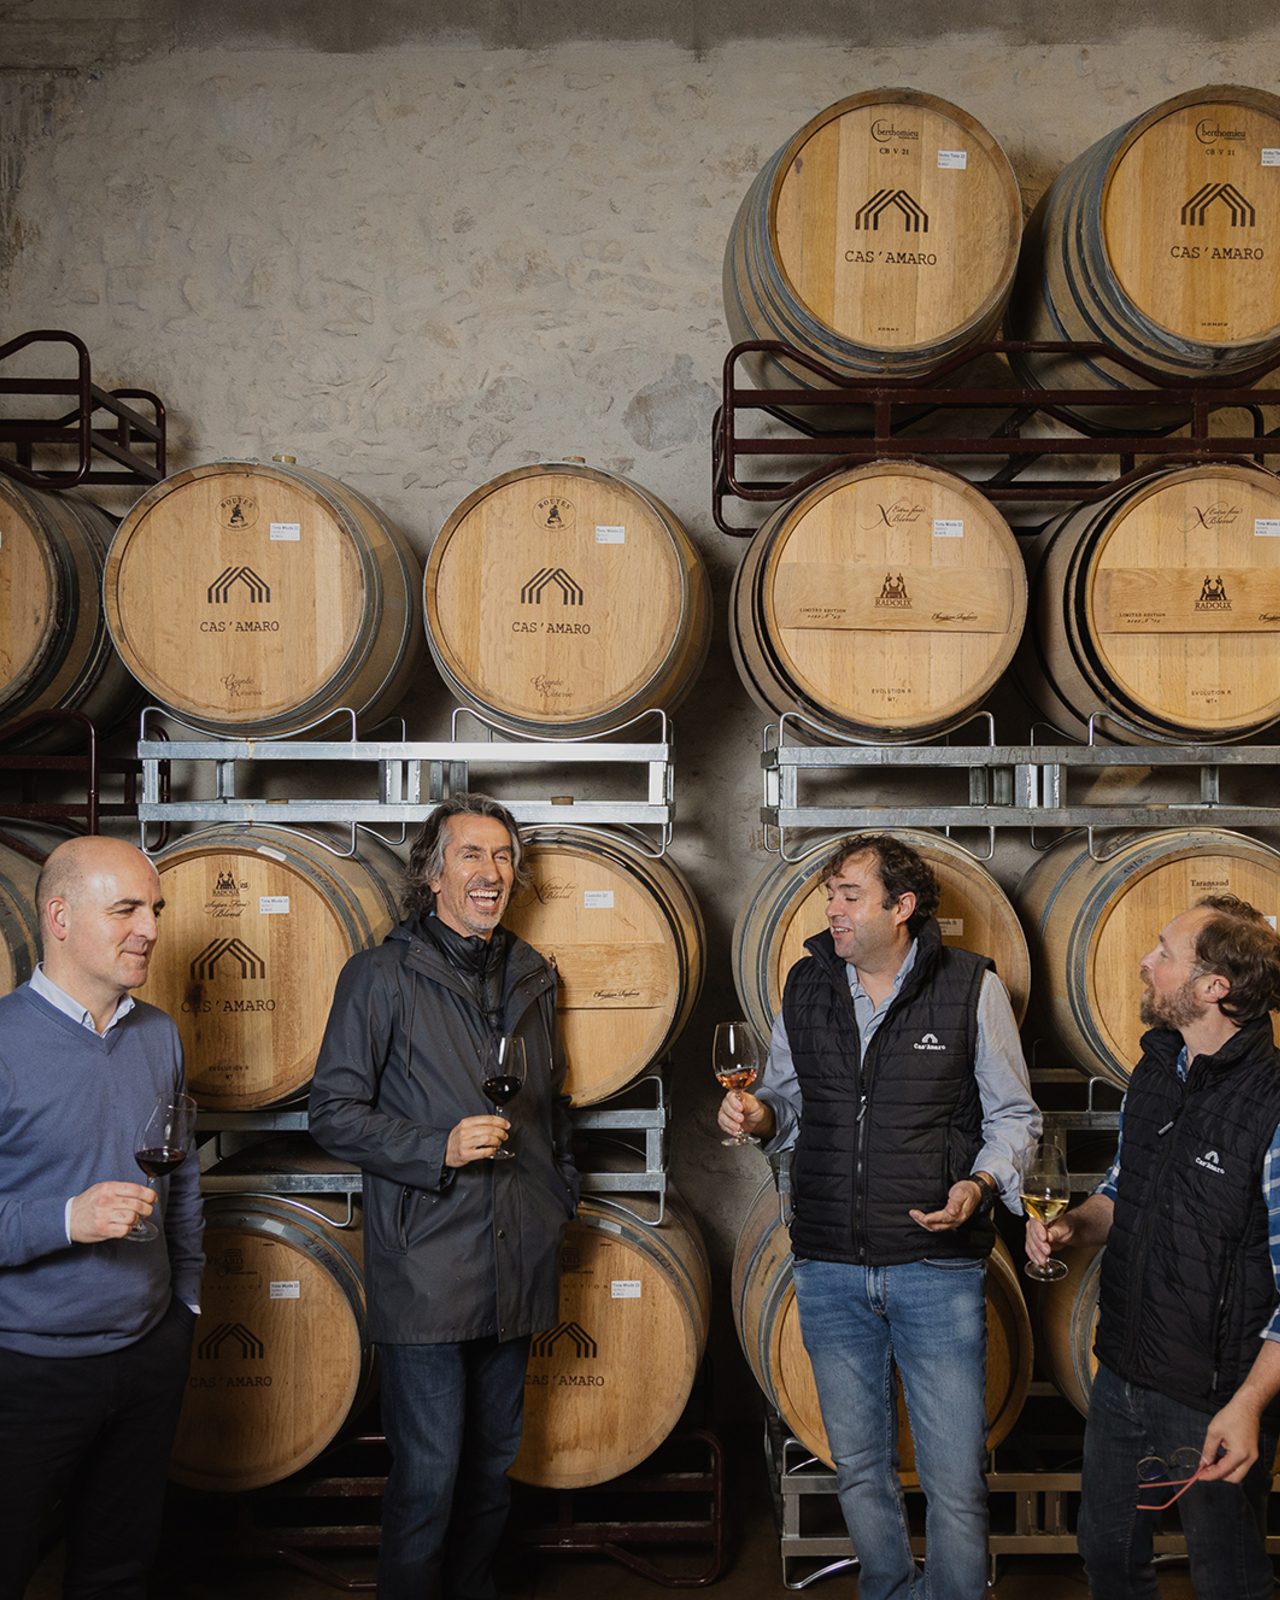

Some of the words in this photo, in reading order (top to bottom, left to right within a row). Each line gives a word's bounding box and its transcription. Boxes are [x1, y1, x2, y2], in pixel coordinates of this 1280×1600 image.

[844, 250, 938, 266] CAS'AMARO
[1170, 245, 1264, 261] CAS'AMARO
[1195, 601, 1232, 610] RADOUX
[199, 620, 281, 633] CAS'AMARO
[511, 621, 592, 635] CAS'AMARO
[206, 1256, 244, 1266] VICARD
